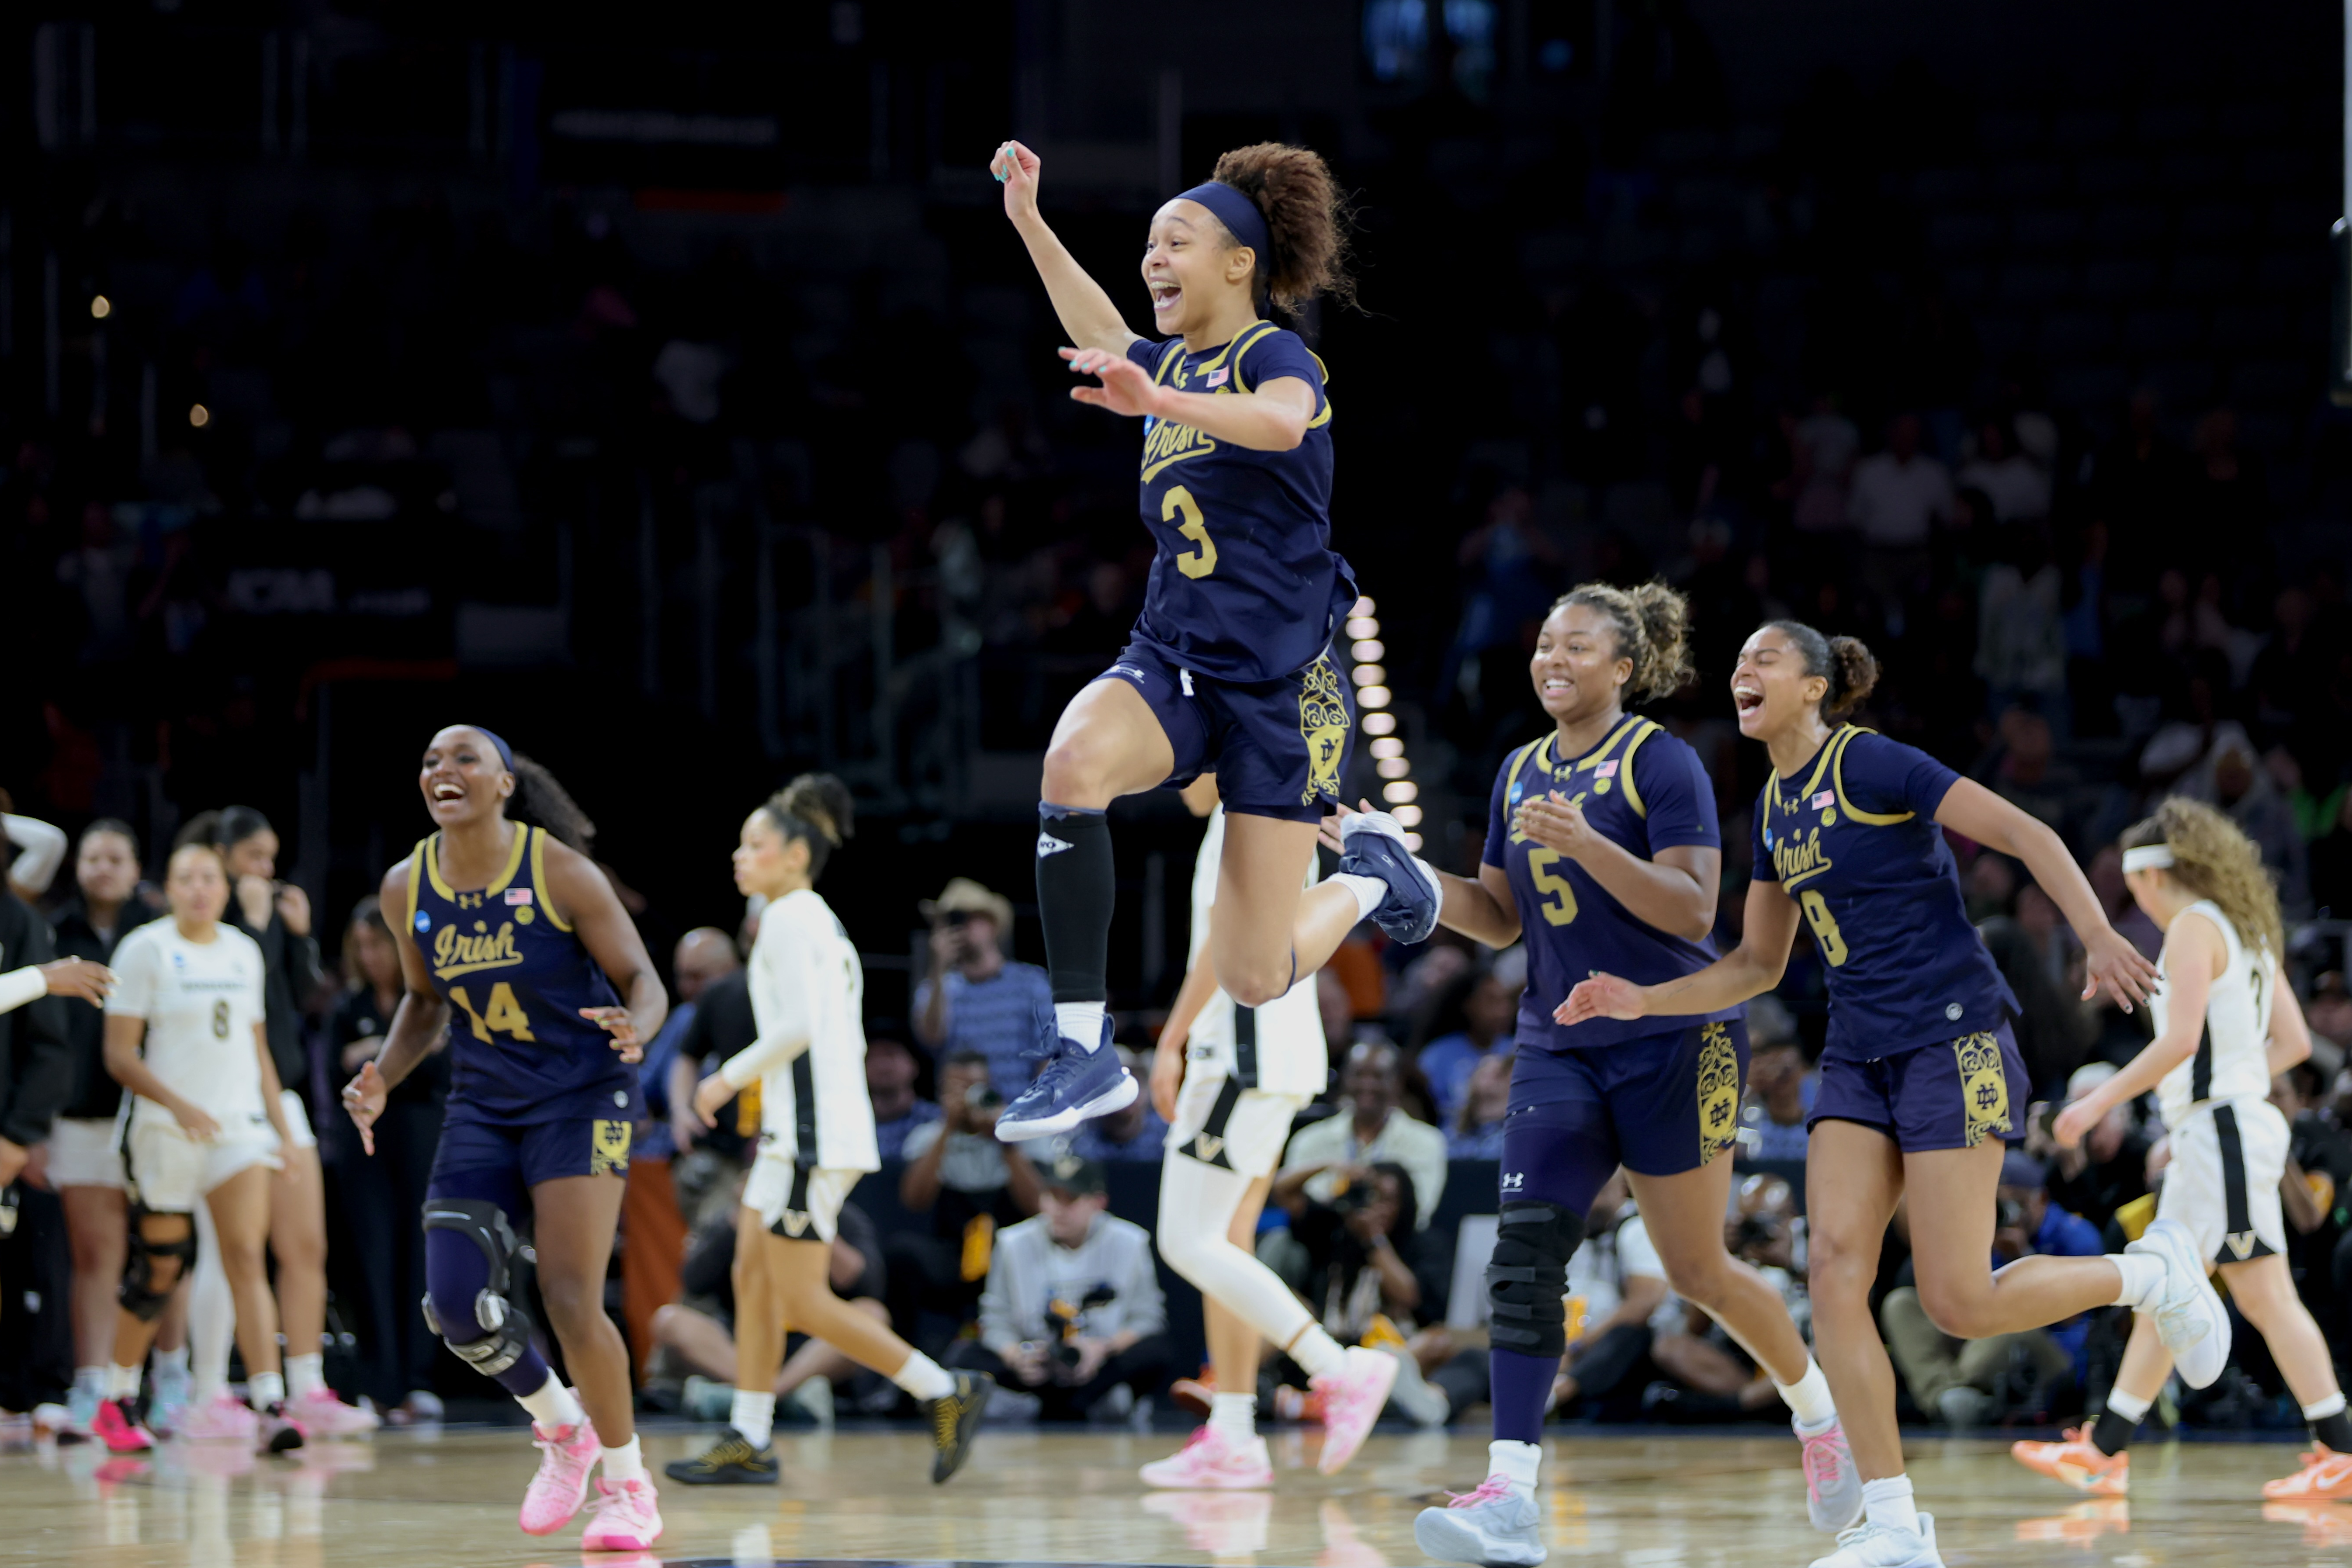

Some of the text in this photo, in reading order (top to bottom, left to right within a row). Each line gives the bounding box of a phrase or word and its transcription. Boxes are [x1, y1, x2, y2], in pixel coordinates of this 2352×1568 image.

[1141, 418, 1216, 485] Irish
[1161, 485, 1218, 580] 3
[1528, 848, 1578, 927] 5
[1773, 826, 1832, 894] Irish
[433, 919, 524, 982] Irish
[1800, 890, 1848, 967] 8
[448, 981, 537, 1046] 14
